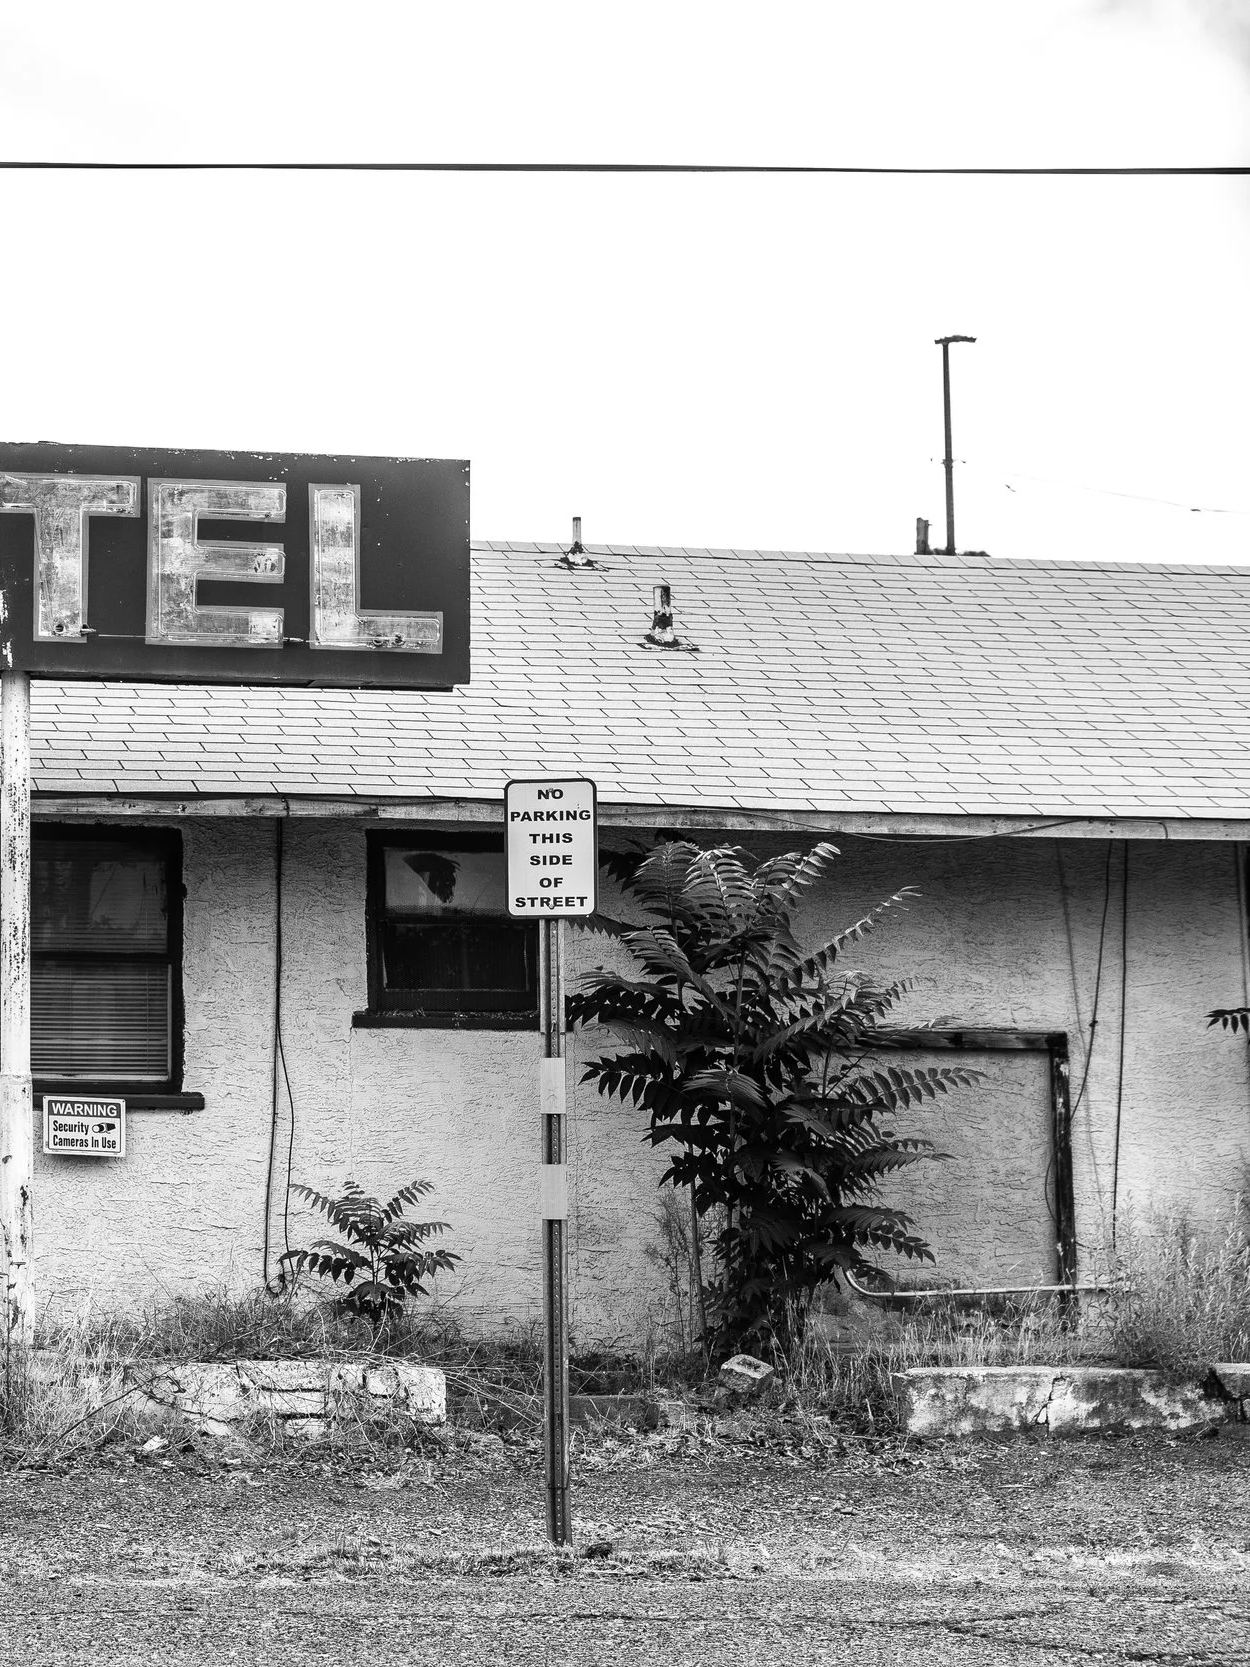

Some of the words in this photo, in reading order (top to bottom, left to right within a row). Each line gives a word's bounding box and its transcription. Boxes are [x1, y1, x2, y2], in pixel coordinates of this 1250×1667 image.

[537, 788, 564, 800] NO
[510, 810, 591, 822] PARKING
[529, 833, 573, 844] THIS
[530, 855, 573, 866] SIDE
[539, 877, 564, 888] OF
[515, 896, 588, 908] STREET
[51, 1102, 117, 1116] WARNING
[53, 1120, 89, 1135] Security
[53, 1134, 89, 1148] Cameras
[91, 1136, 99, 1148] In
[101, 1136, 117, 1149] Use
